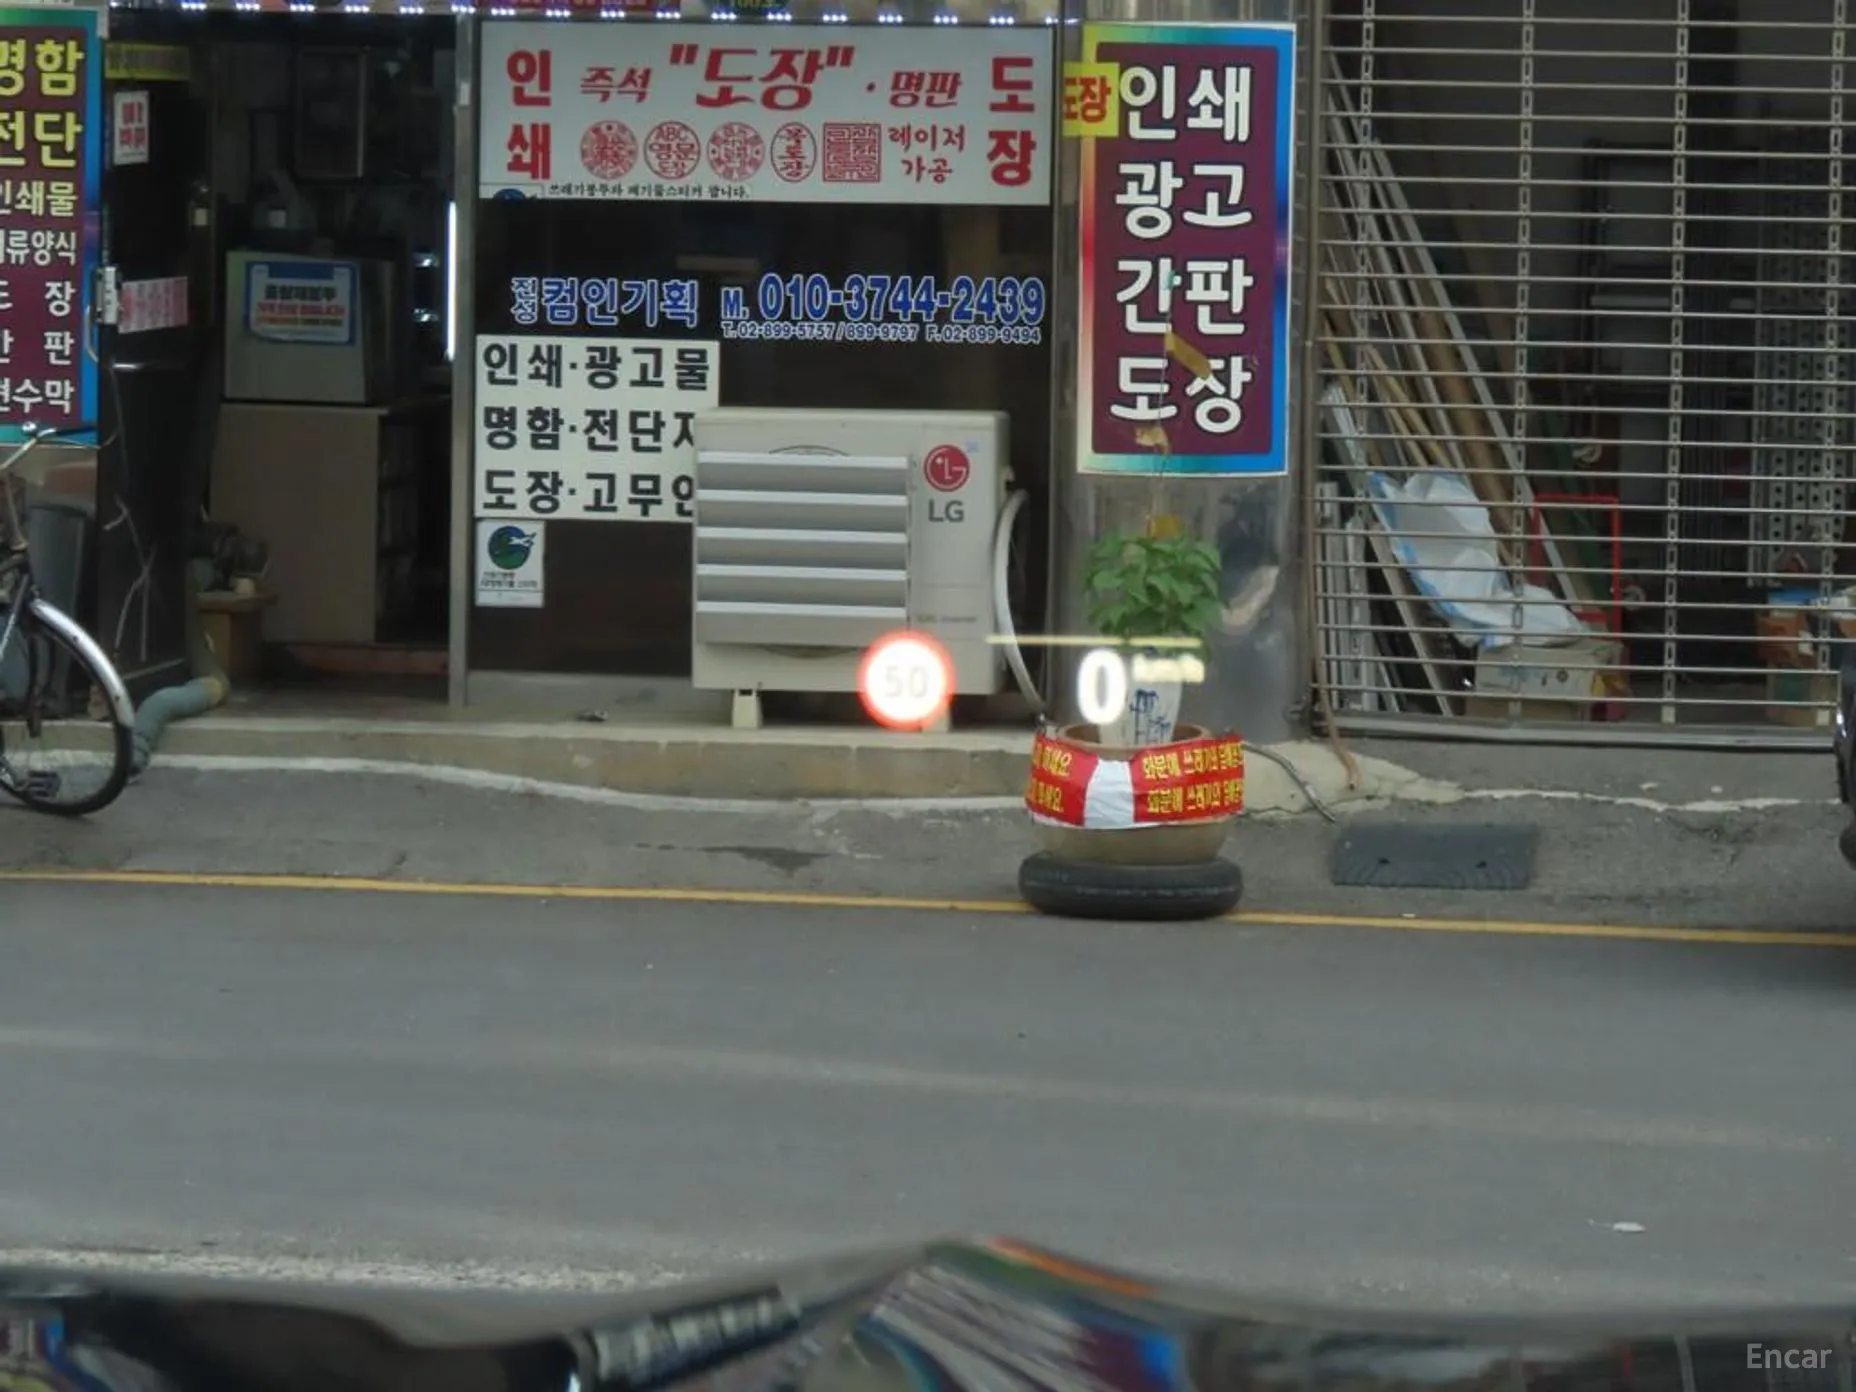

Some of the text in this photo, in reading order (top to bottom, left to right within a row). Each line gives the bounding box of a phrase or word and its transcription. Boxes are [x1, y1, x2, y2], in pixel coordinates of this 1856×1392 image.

[580, 66, 652, 104] 즉석
[889, 71, 962, 108] 명판
[1118, 65, 1252, 142] 인쇄
[888, 123, 966, 152] 레이저
[901, 155, 953, 184] 가공
[1116, 161, 1254, 239] 광고
[0, 229, 77, 266] 류양식
[721, 272, 1046, 326] M. 010-3744-2439
[1115, 257, 1254, 335] 간판
[1110, 355, 1253, 433] 도장
[928, 499, 965, 523] LG
[884, 665, 929, 698] 50
[1078, 648, 1126, 725] 0
